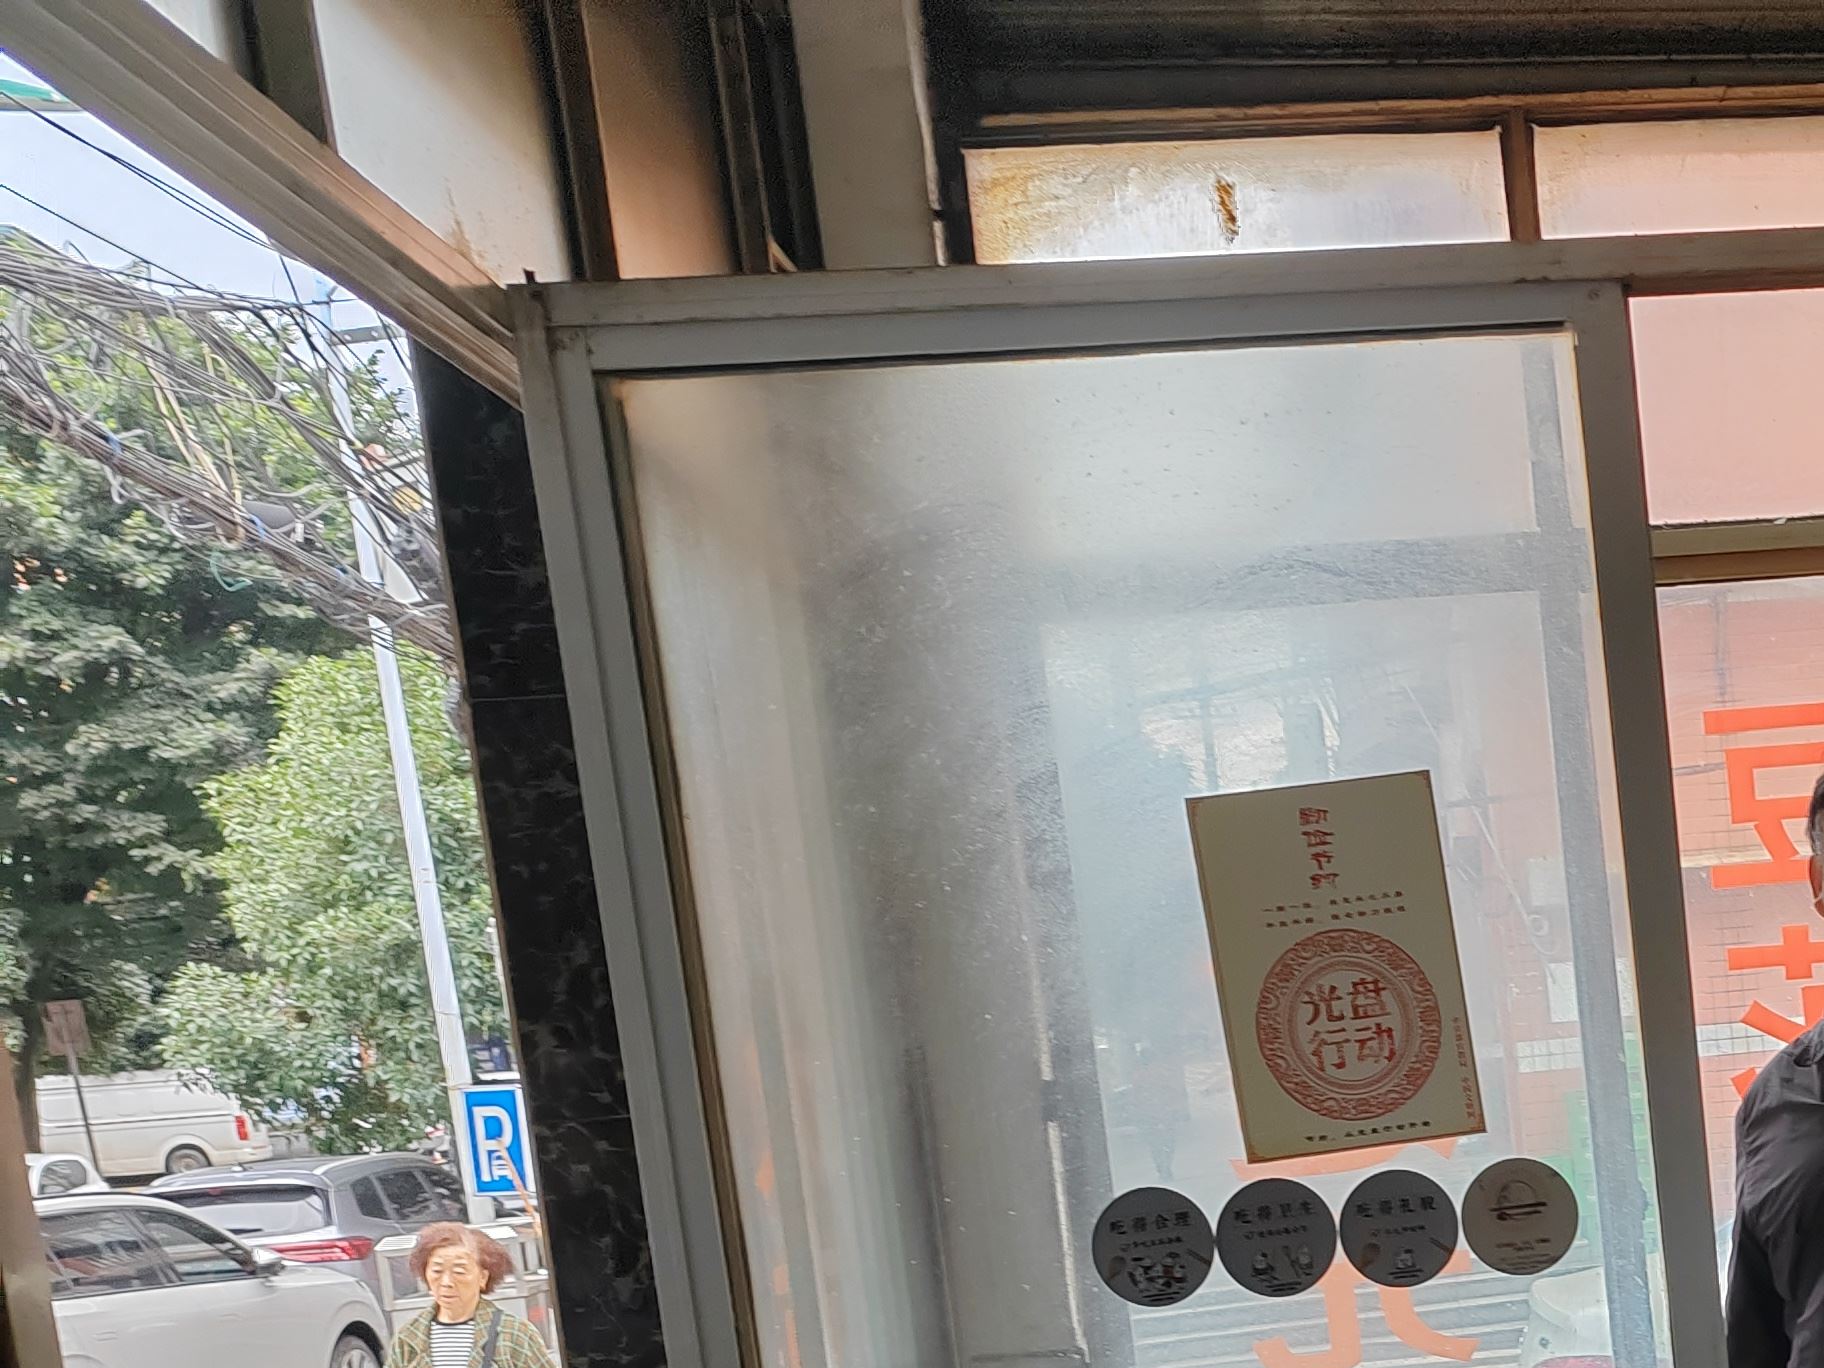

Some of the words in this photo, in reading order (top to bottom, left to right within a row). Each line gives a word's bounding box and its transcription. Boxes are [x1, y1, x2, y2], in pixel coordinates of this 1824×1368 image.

[1301, 977, 1392, 1026] 光盘
[1308, 1022, 1397, 1073] 行动
[471, 1105, 513, 1182] P
